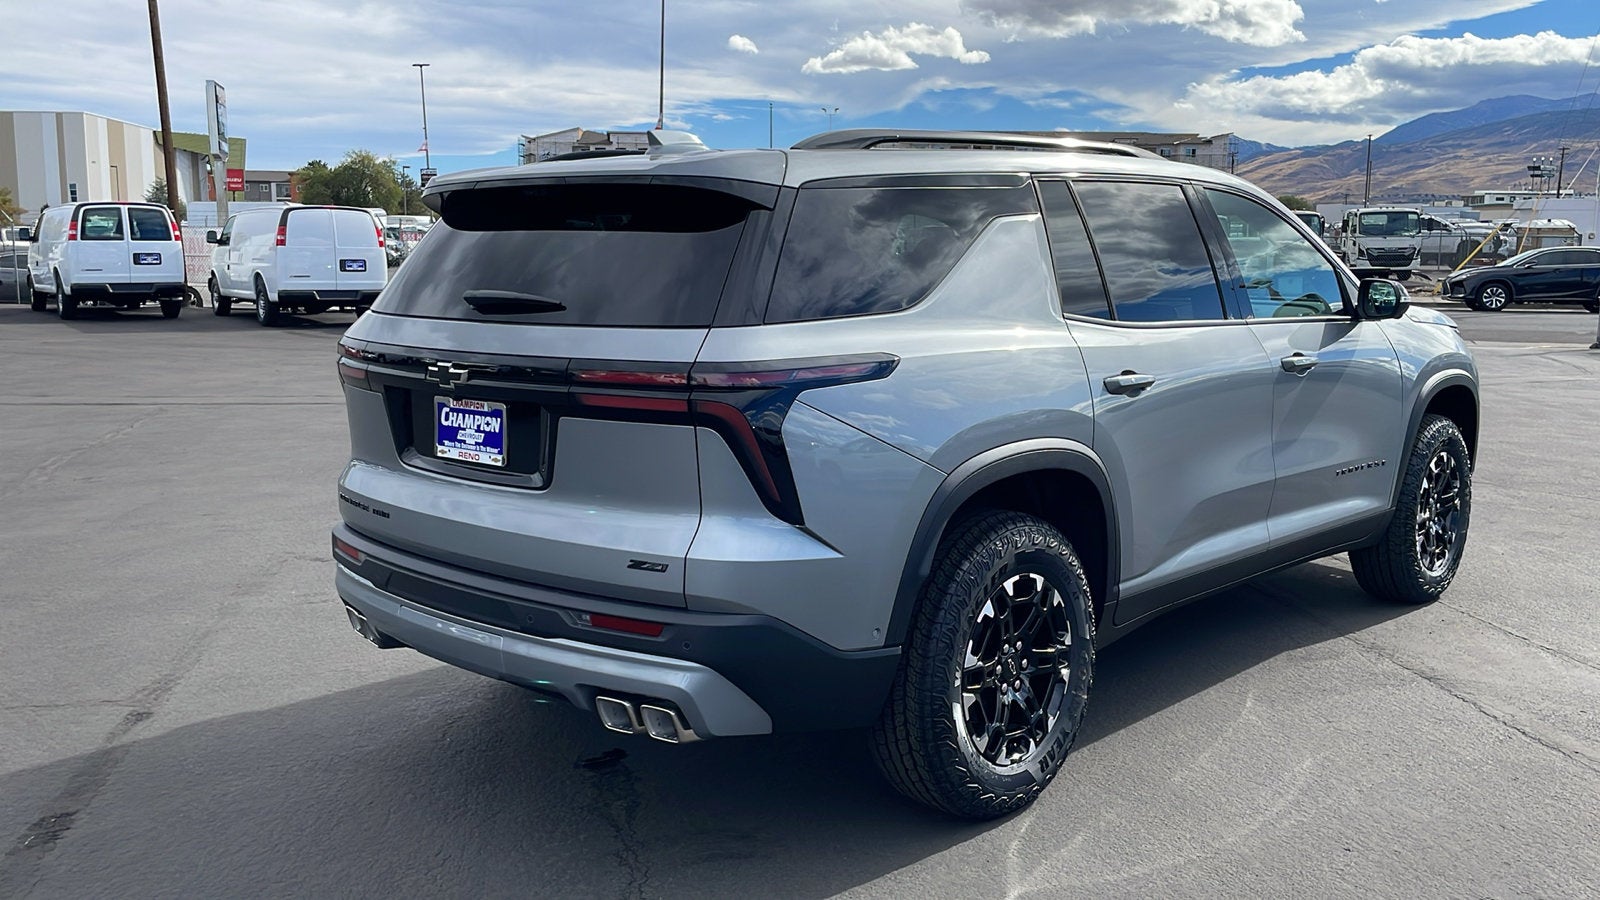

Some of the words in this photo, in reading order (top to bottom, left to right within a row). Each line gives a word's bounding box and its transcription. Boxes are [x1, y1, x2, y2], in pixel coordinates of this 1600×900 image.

[451, 400, 485, 410] CHAMPION
[440, 407, 501, 433] CHAMPION
[458, 431, 483, 441] CHEVROLET
[458, 451, 480, 461] RENO
